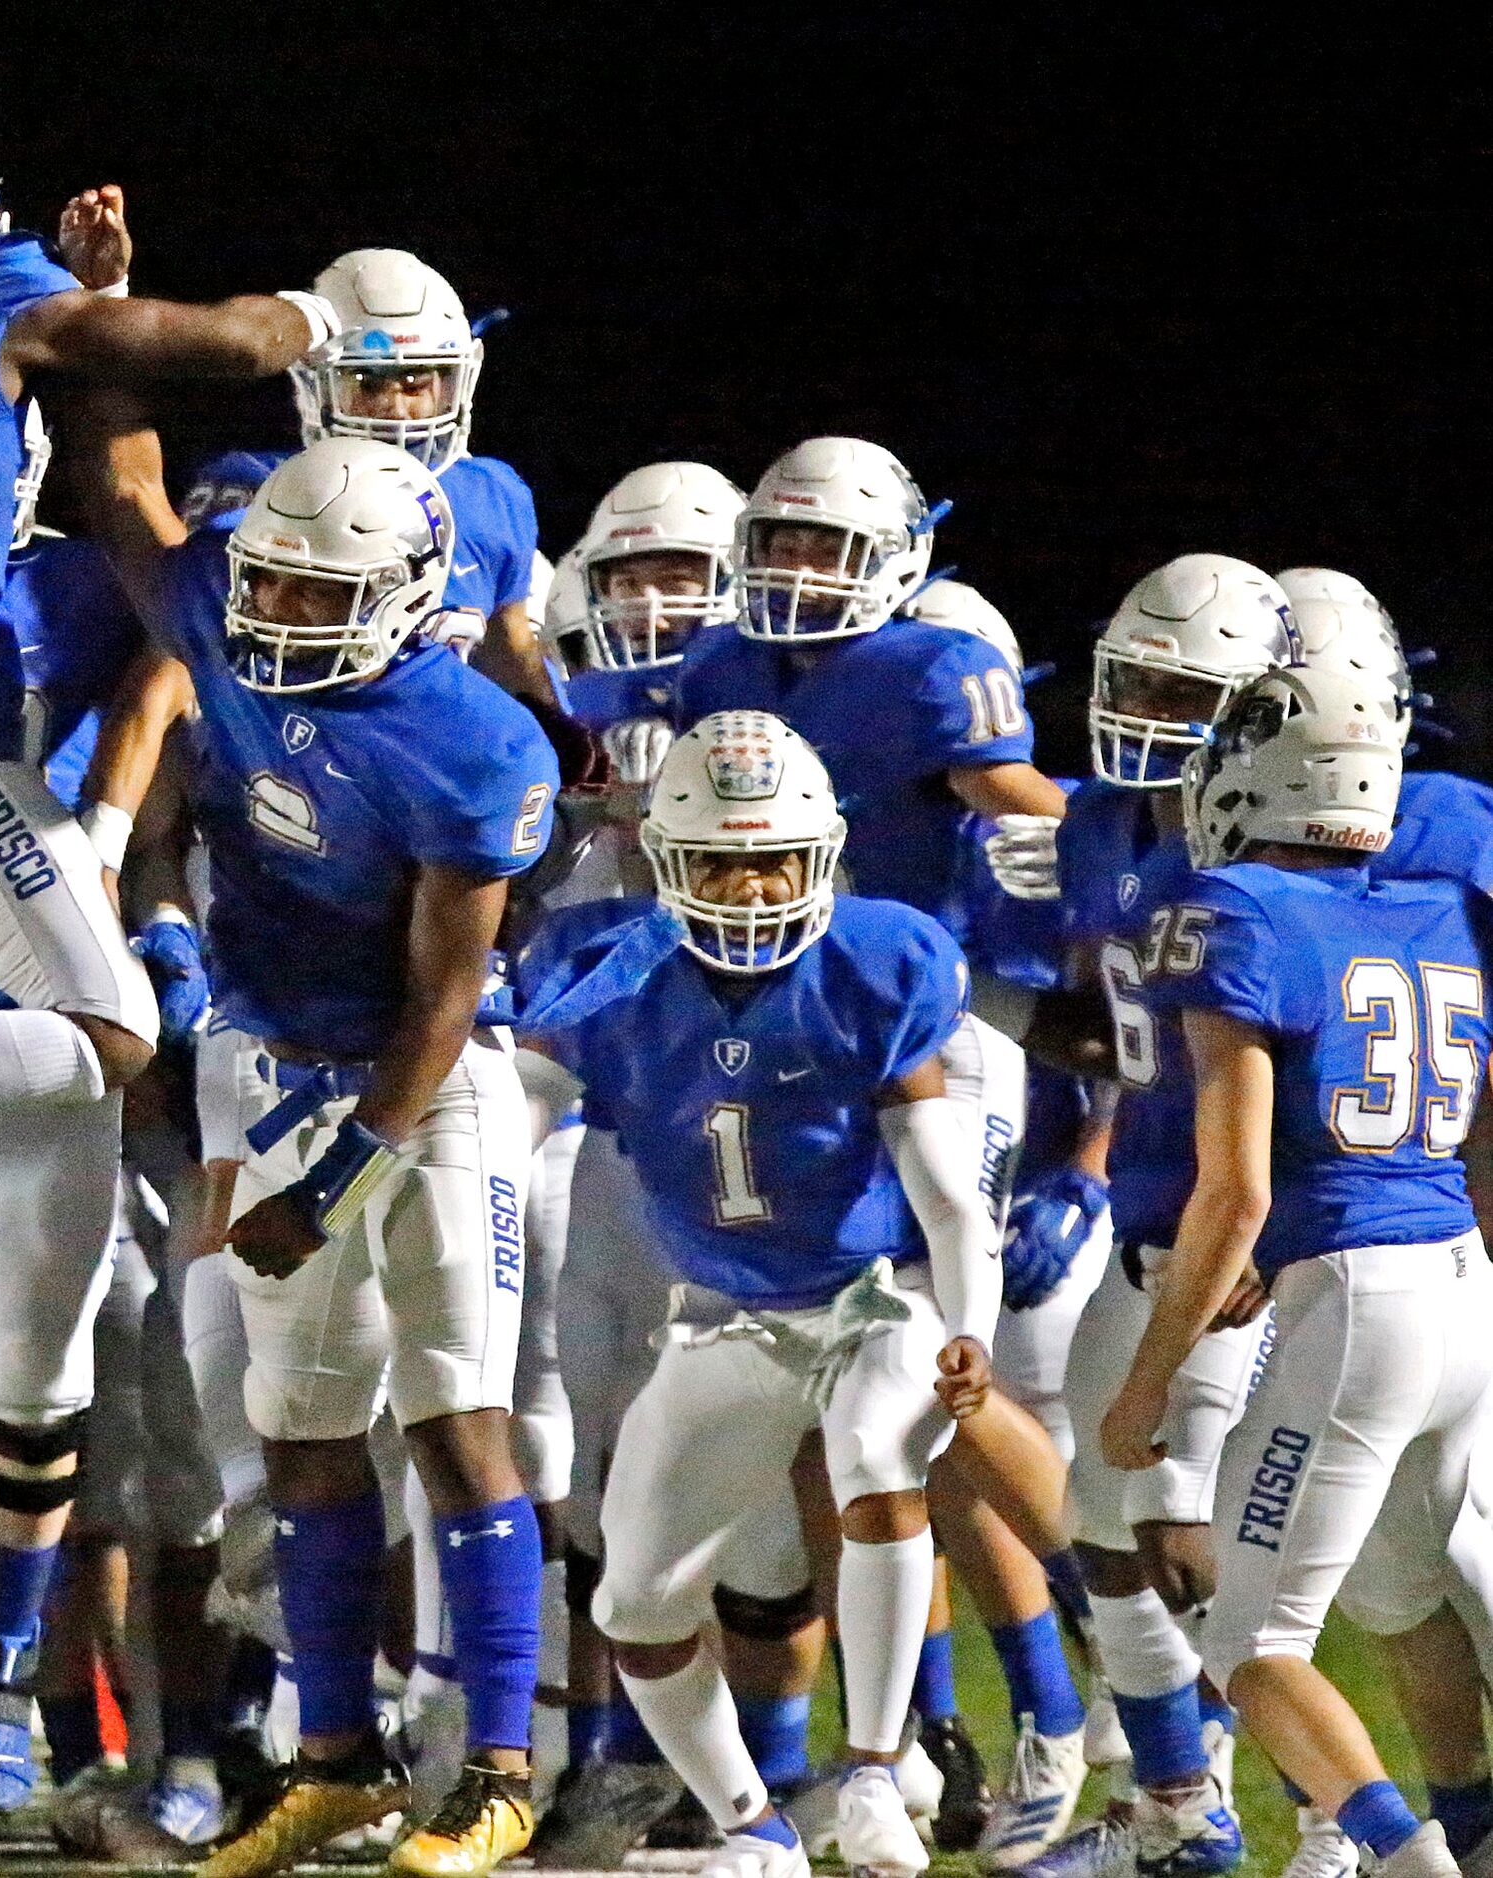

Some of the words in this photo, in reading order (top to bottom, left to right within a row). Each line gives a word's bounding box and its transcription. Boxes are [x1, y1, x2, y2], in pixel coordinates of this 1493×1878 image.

[961, 667, 1025, 744] 10
[510, 782, 552, 856] 2
[1305, 822, 1387, 850] Riddell
[1330, 957, 1485, 1160] 35
[703, 1101, 772, 1227] 1
[494, 1175, 522, 1296] FRISCO
[1238, 1427, 1311, 1555] FRISCO
